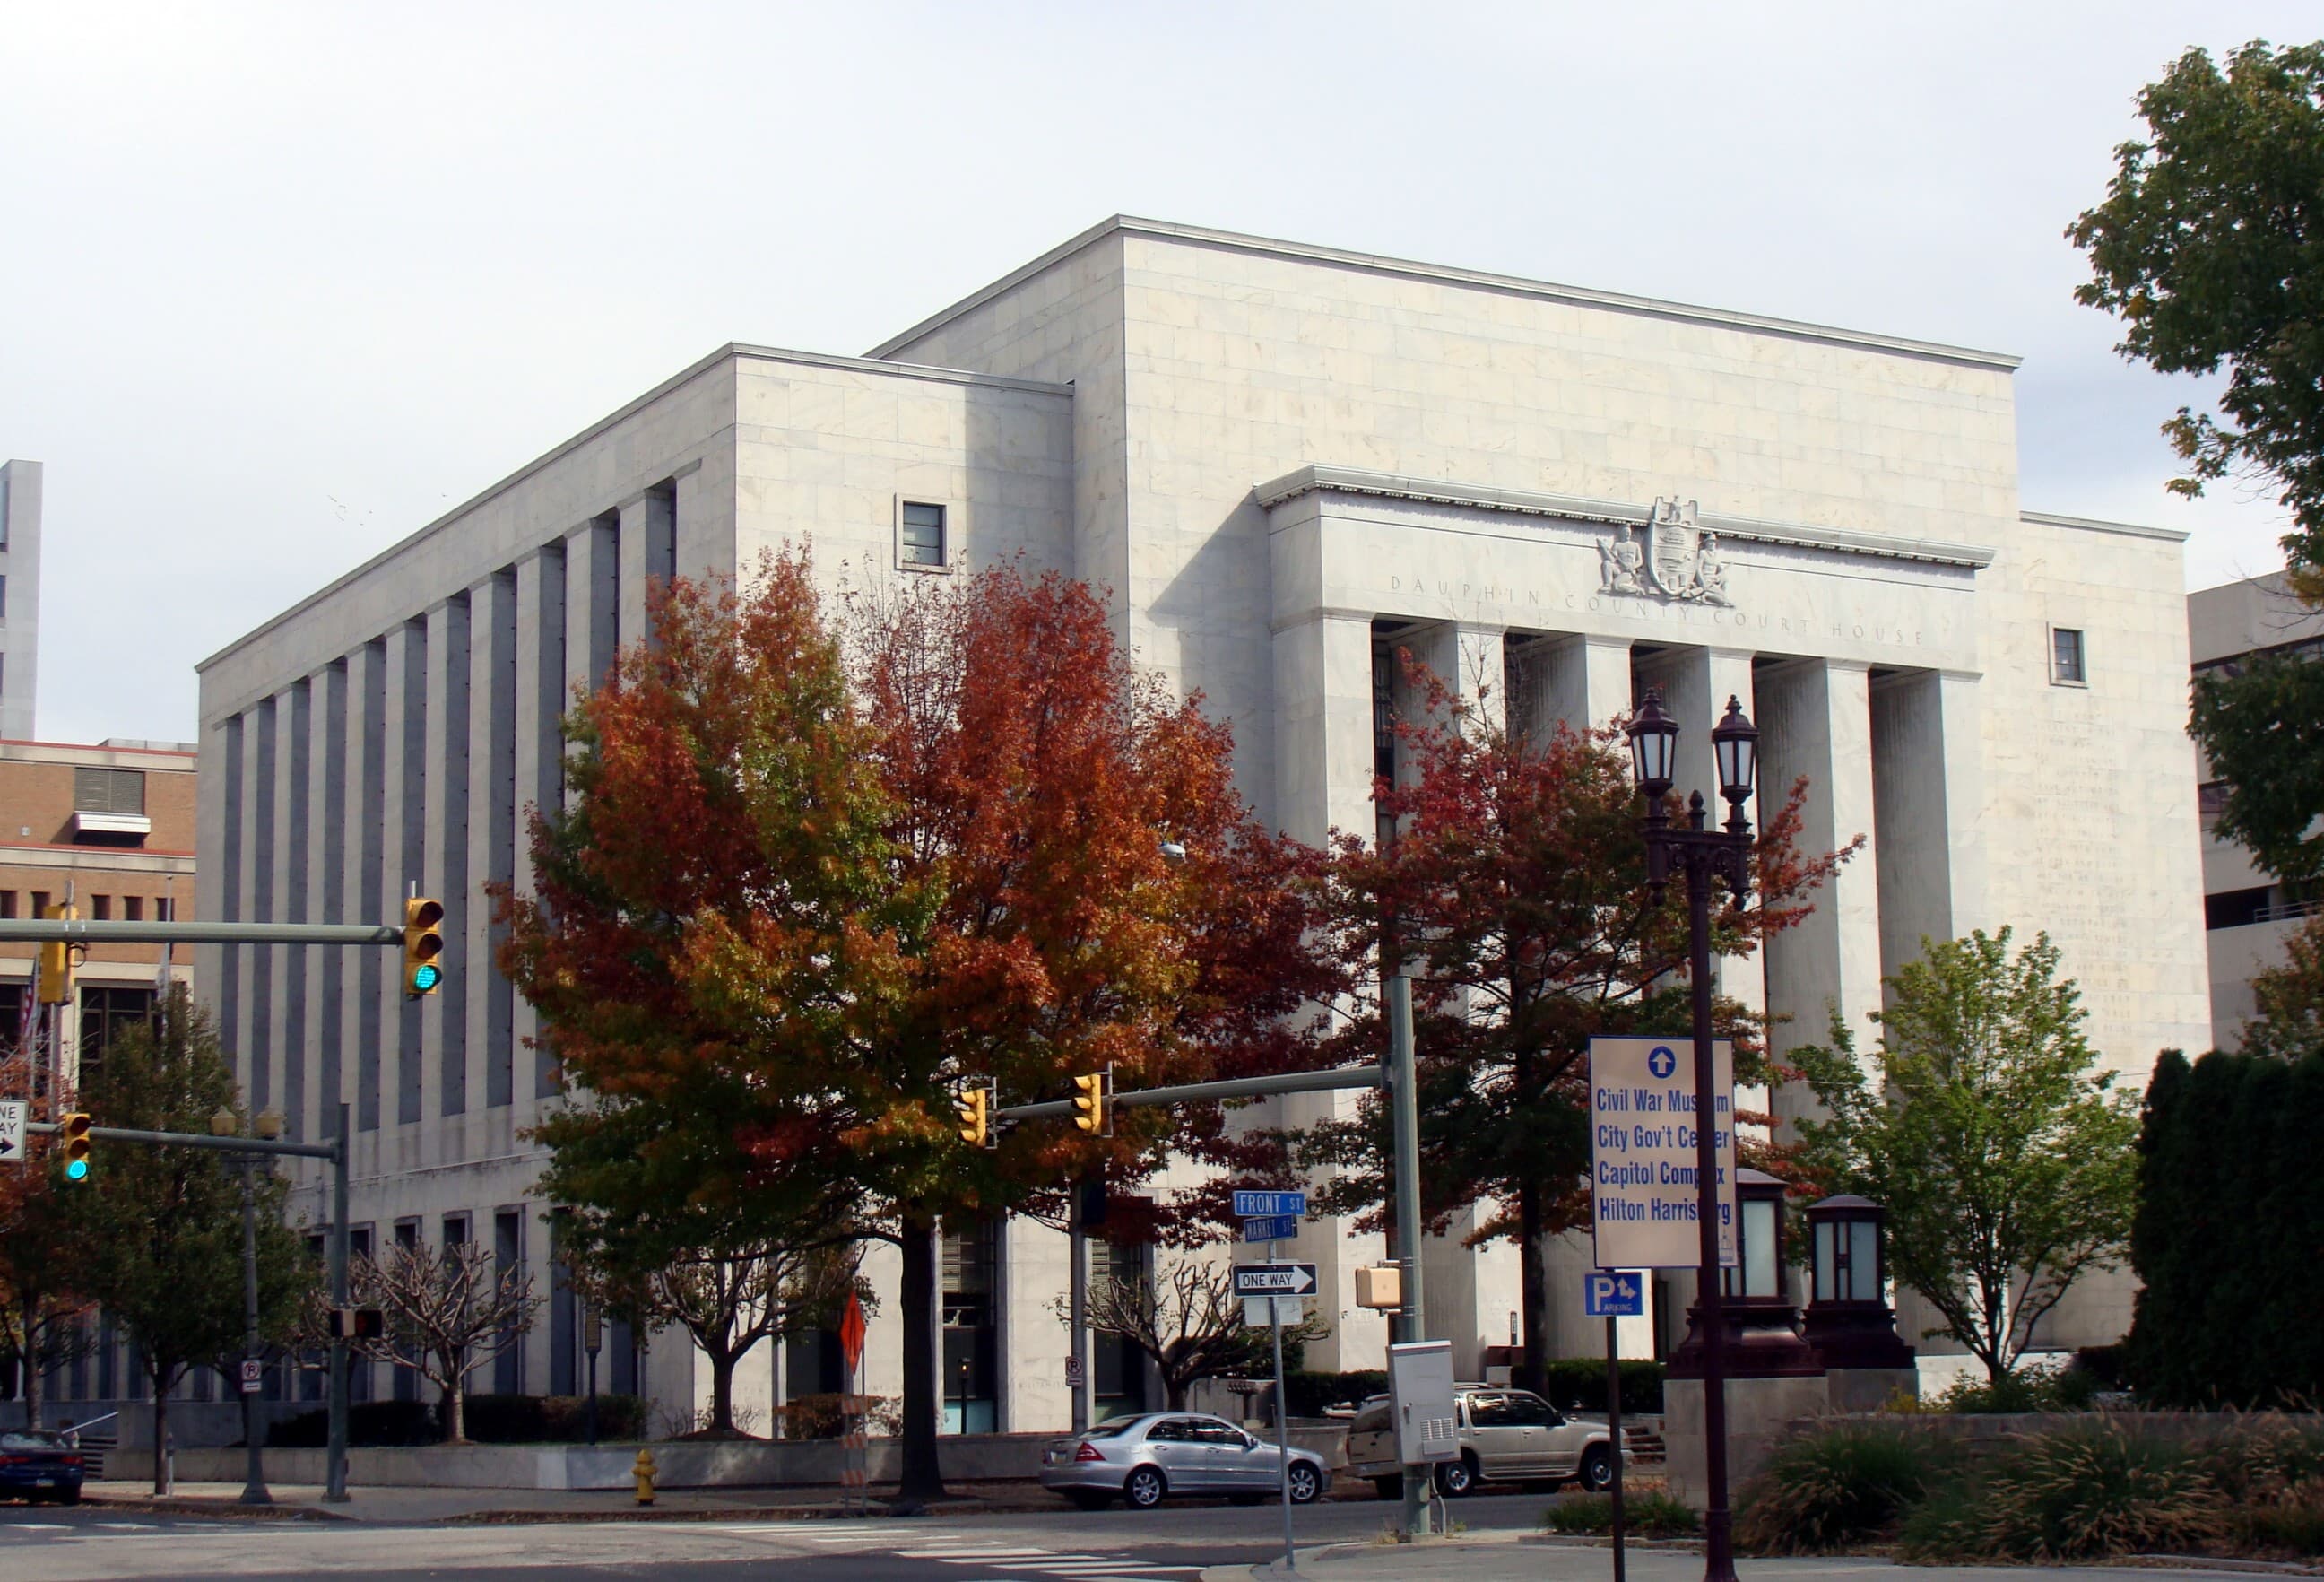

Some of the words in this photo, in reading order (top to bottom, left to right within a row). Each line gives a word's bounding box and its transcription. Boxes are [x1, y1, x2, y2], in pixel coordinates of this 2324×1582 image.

[1391, 575, 1539, 605] DAUPHIN
[1565, 595, 1690, 621] COUNTY
[1713, 610, 1809, 632] COURT
[1832, 623, 1923, 645] HOUSE
[1597, 1088, 1628, 1112] Civil
[1634, 1089, 1662, 1112] War
[1668, 1090, 1729, 1112] Musm
[0, 1106, 17, 1119] NE
[0, 1122, 18, 1134] AY
[1598, 1125, 1628, 1152] City
[1634, 1125, 1673, 1149] Gov't
[1678, 1125, 1730, 1149] Ceer
[1599, 1160, 1654, 1189] Capitol
[1660, 1161, 1725, 1190] Compx
[1240, 1195, 1281, 1213] FRONT
[1289, 1197, 1301, 1211] ST
[1600, 1197, 1645, 1221] Hilton
[1651, 1197, 1730, 1226] Harrisrg
[1246, 1219, 1277, 1241] MARKET
[1243, 1274, 1266, 1287] ONE
[1269, 1273, 1293, 1287] WAY
